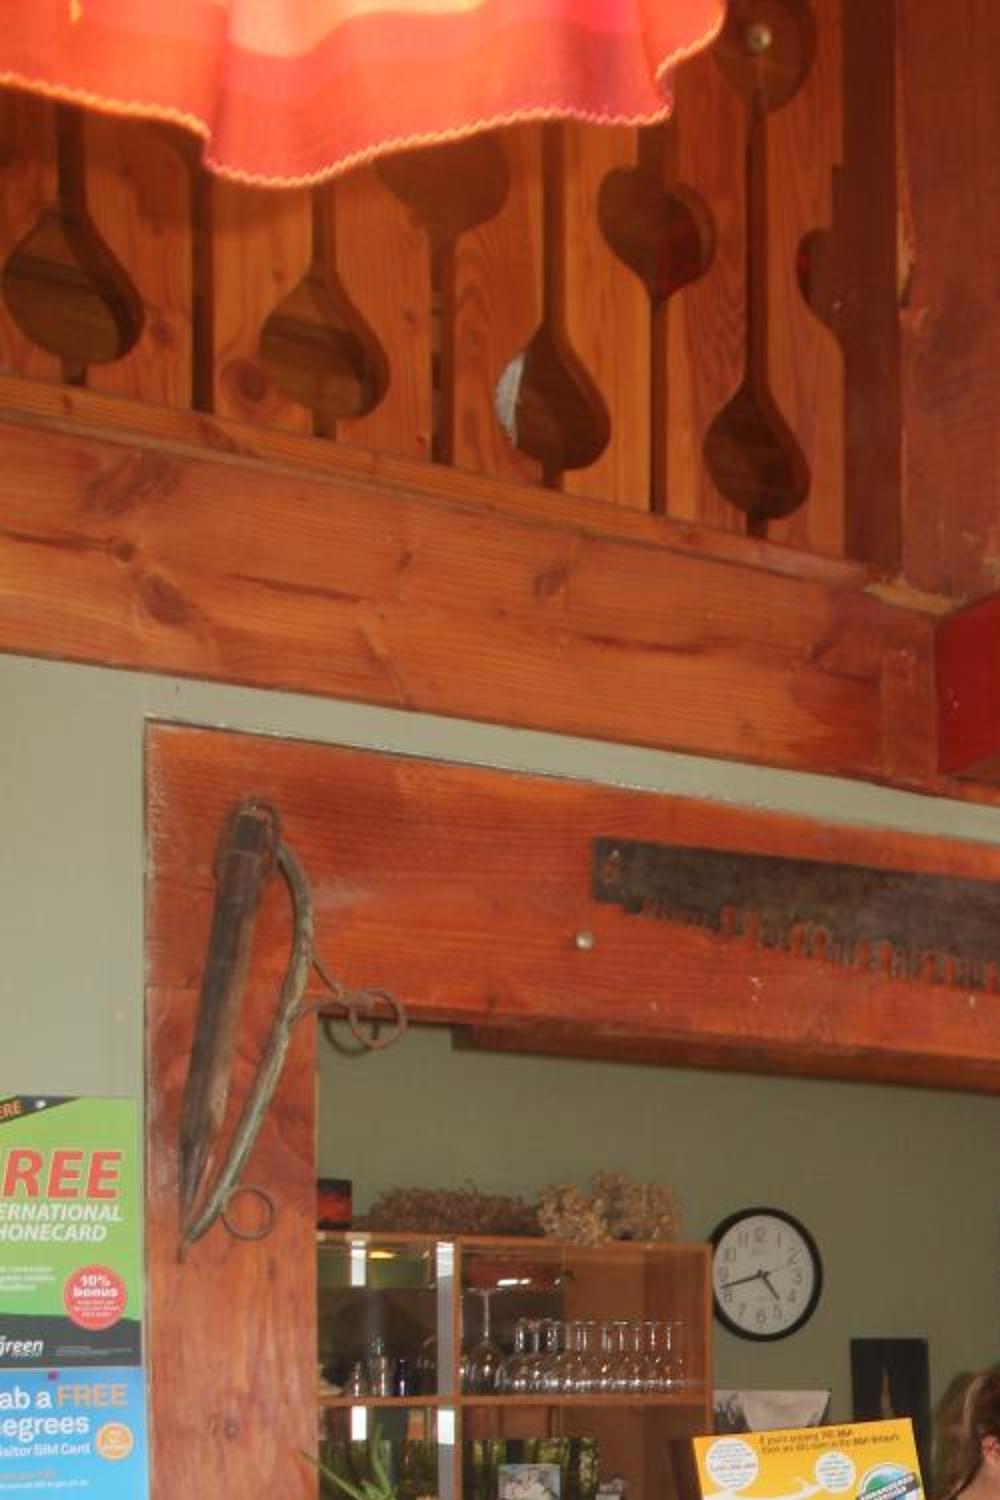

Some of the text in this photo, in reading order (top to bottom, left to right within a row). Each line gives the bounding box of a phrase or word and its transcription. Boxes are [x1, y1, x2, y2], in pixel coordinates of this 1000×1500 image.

[3, 1149, 122, 1200] REE
[73, 1285, 119, 1298] bonus
[35, 1391, 52, 1409] a
[57, 1383, 128, 1409] FREE
[0, 1416, 90, 1443] egrees
